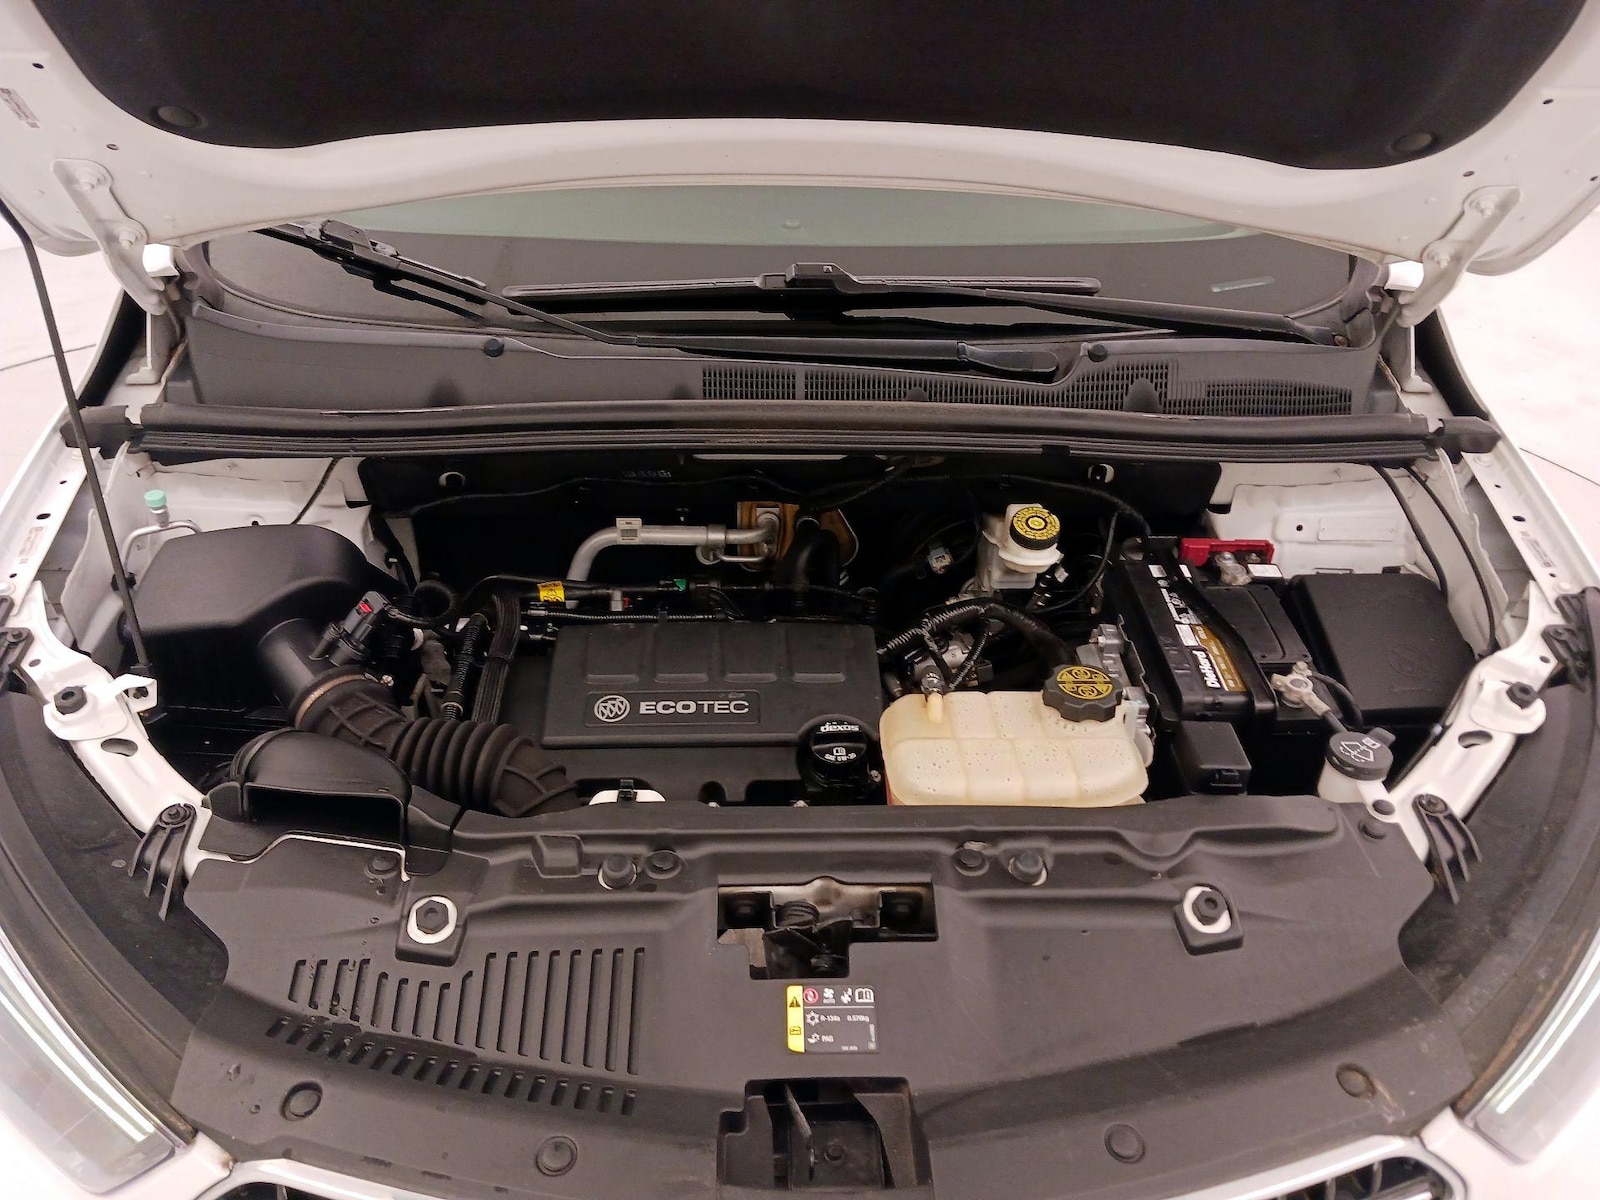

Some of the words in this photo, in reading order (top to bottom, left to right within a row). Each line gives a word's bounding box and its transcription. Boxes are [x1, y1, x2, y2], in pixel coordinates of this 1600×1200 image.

[1192, 650, 1221, 688] DieHard
[639, 700, 750, 715] ECOTEC
[820, 722, 860, 732] dexos
